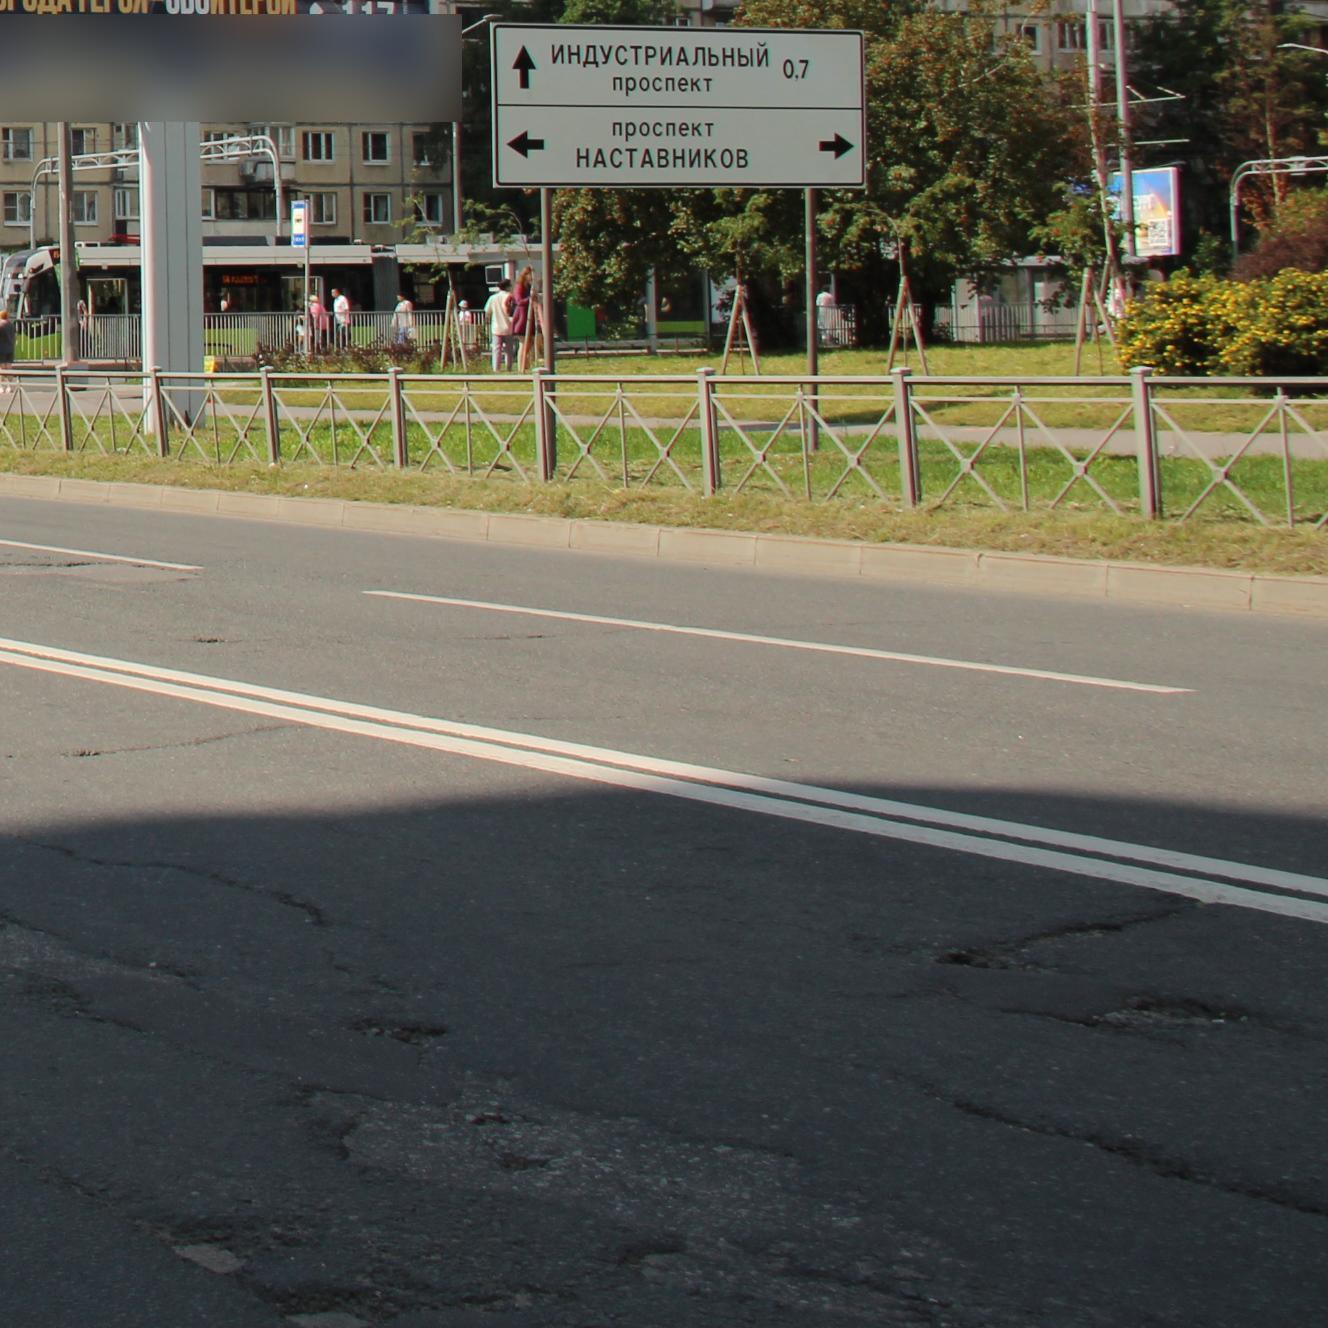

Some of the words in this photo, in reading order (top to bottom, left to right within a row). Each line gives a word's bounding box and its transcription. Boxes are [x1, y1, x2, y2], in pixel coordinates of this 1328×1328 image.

[551, 42, 769, 68] ИНДУСТРИАЛЬНЫЙ
[782, 59, 809, 81] 0,7
[612, 75, 713, 96] проспект
[611, 120, 714, 141] проспект
[576, 148, 749, 169] НАСТАВНИКОВ
